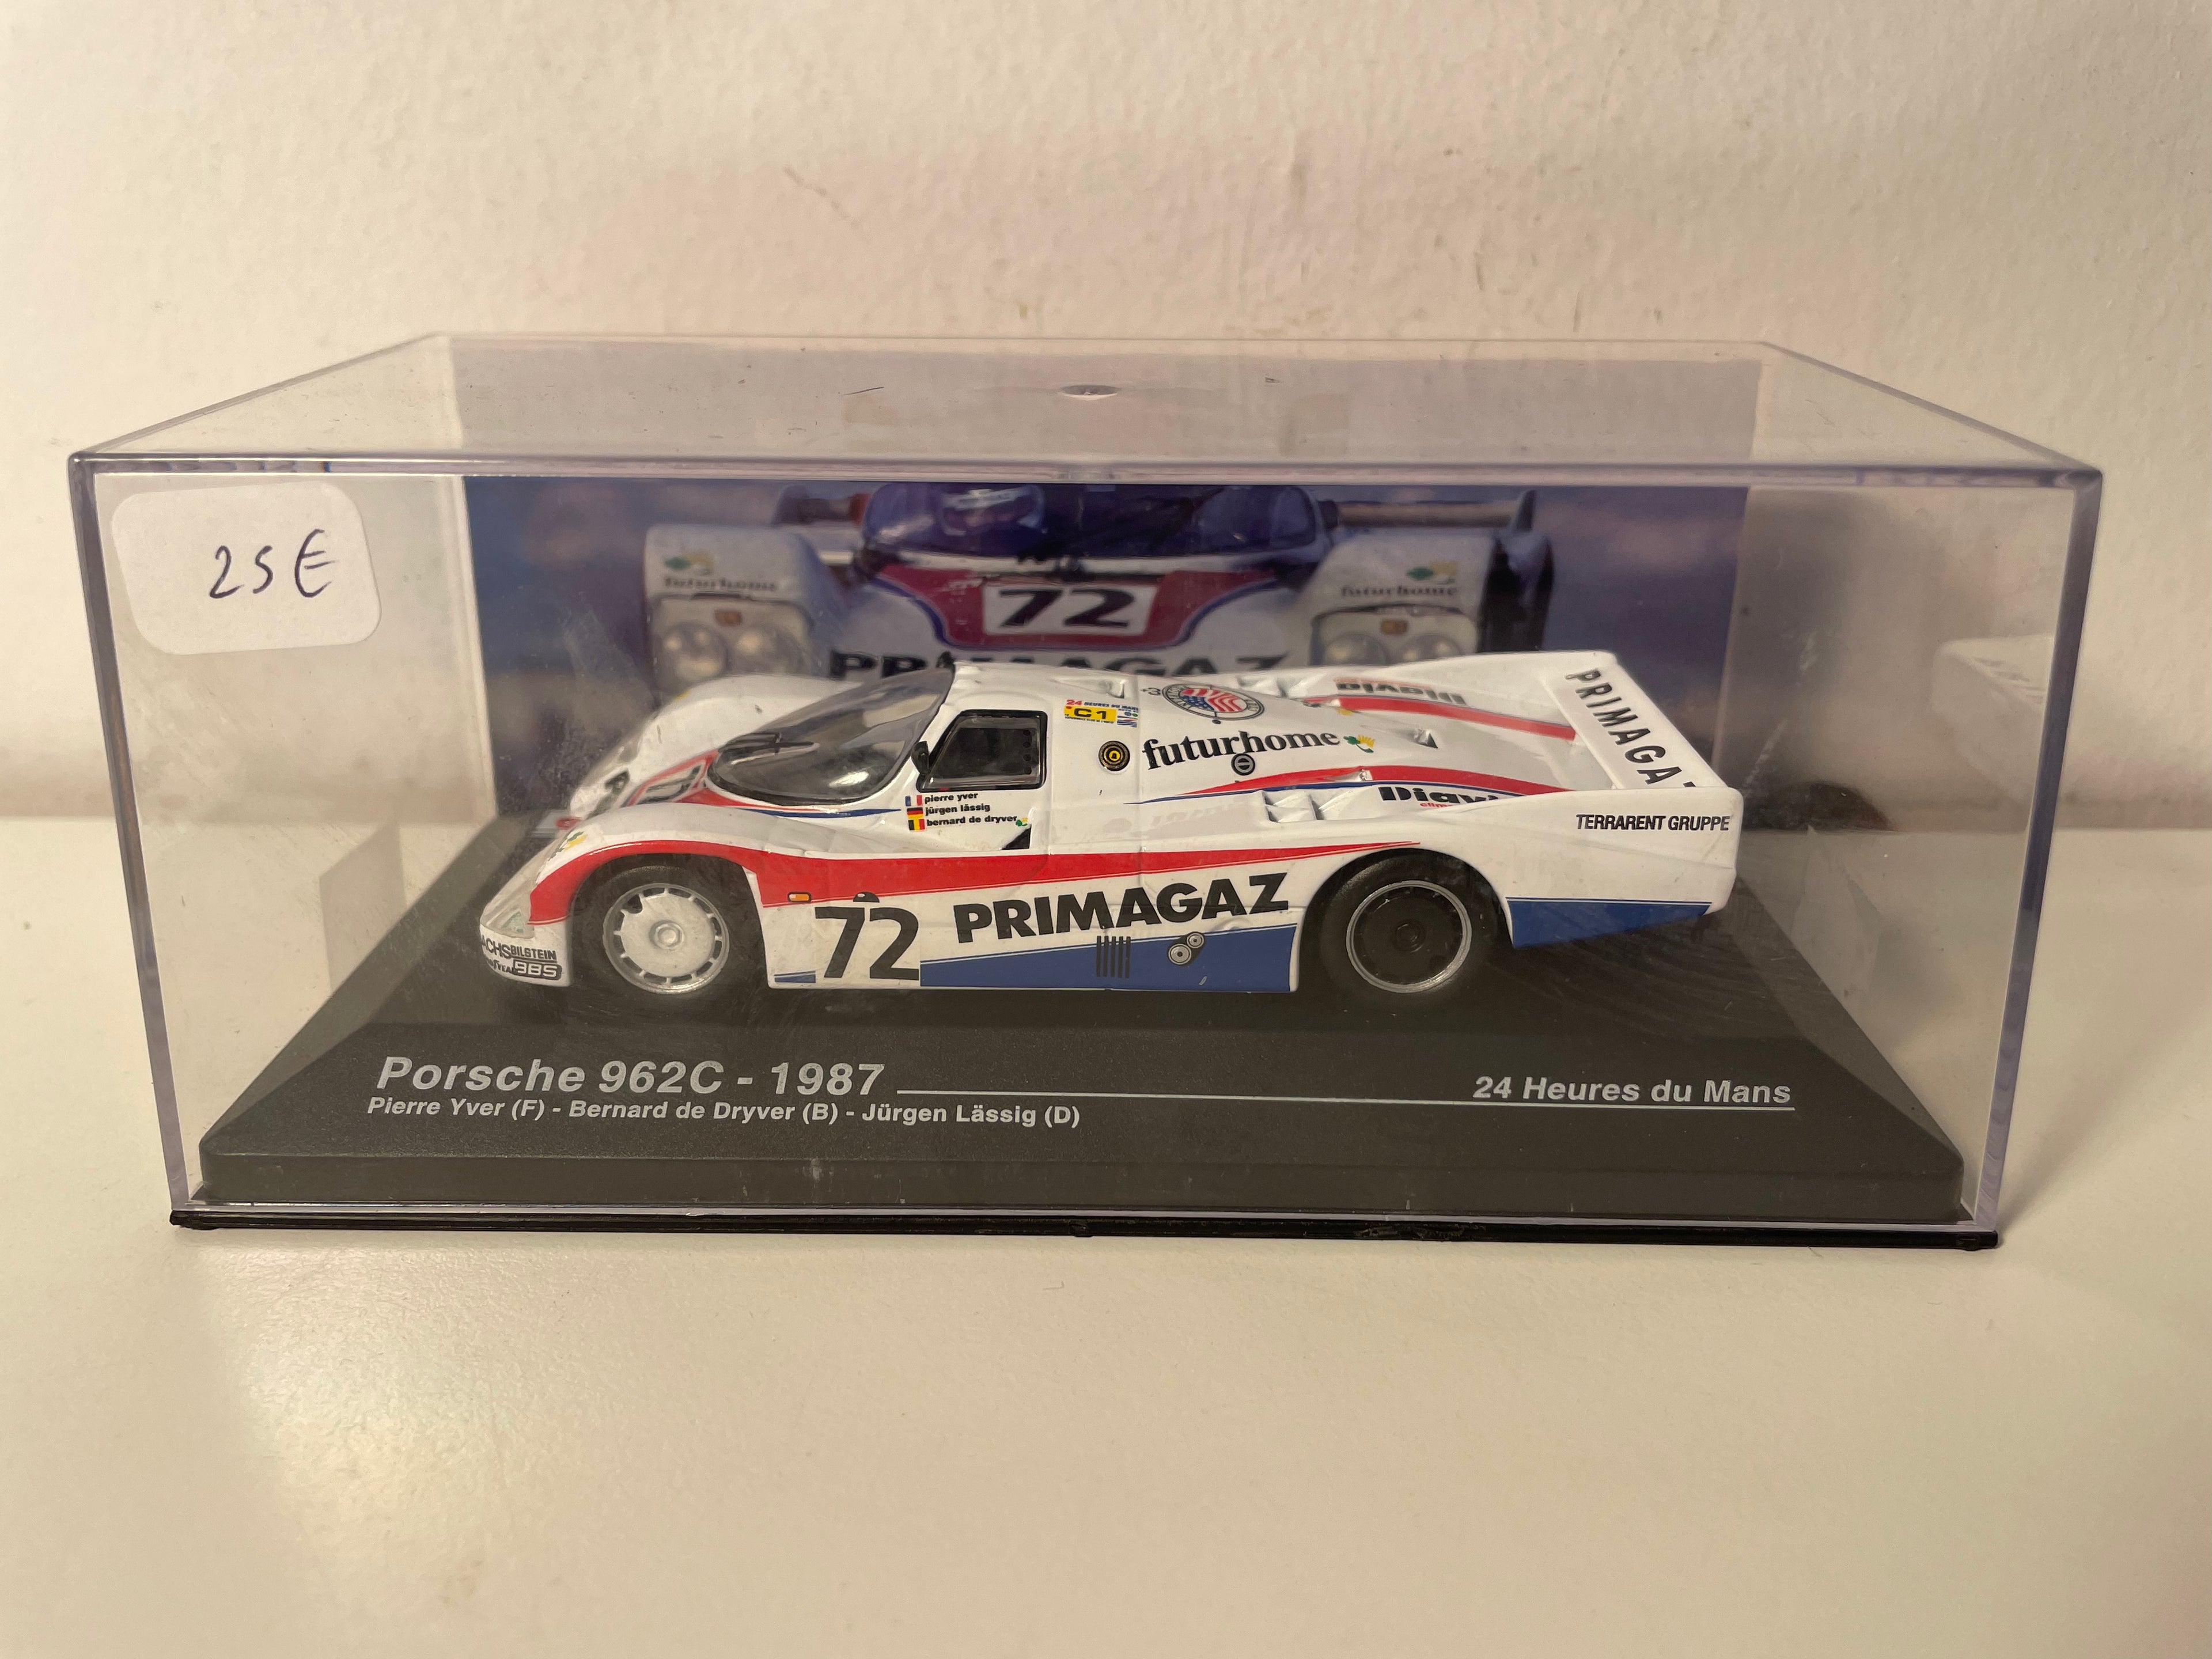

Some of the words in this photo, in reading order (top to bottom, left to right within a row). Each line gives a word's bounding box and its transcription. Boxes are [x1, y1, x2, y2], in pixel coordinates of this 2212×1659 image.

[999, 589, 1134, 627] 72
[1565, 668, 1696, 787] PRIMAGA
[1142, 730, 1340, 770] futurhome
[925, 794, 954, 804] pierre
[957, 793, 979, 801] yver
[925, 805, 957, 816] jürgen
[960, 803, 991, 812] lässig
[926, 816, 965, 826] bernard
[969, 815, 981, 823] de
[984, 815, 1017, 824] dryver
[1576, 814, 1666, 830] TERRARENT
[1668, 816, 1730, 831] GRUPPE
[953, 872, 1289, 943] PRIMAGAZ
[480, 934, 512, 959] ACHS
[510, 945, 557, 960] BILSTEIN
[815, 906, 919, 980] 72
[377, 1056, 585, 1092] Porsche
[599, 1060, 724, 1093] 962C
[771, 1062, 885, 1095] 1987
[1472, 1076, 1512, 1099] 24
[1522, 1077, 1641, 1101] Heures
[1651, 1080, 1692, 1103] du
[1703, 1080, 1791, 1104] Mans
[368, 1097, 441, 1115] Pierre
[451, 1098, 505, 1116] Yver
[511, 1099, 546, 1121] (F)
[569, 1100, 669, 1119] Bernard
[676, 1102, 705, 1119] de
[714, 1103, 795, 1124] Dryver
[802, 1103, 838, 1125] (B)
[862, 1103, 947, 1126] Jürgen
[956, 1104, 1036, 1127] Lässig
[1044, 1105, 1080, 1128] (D)
